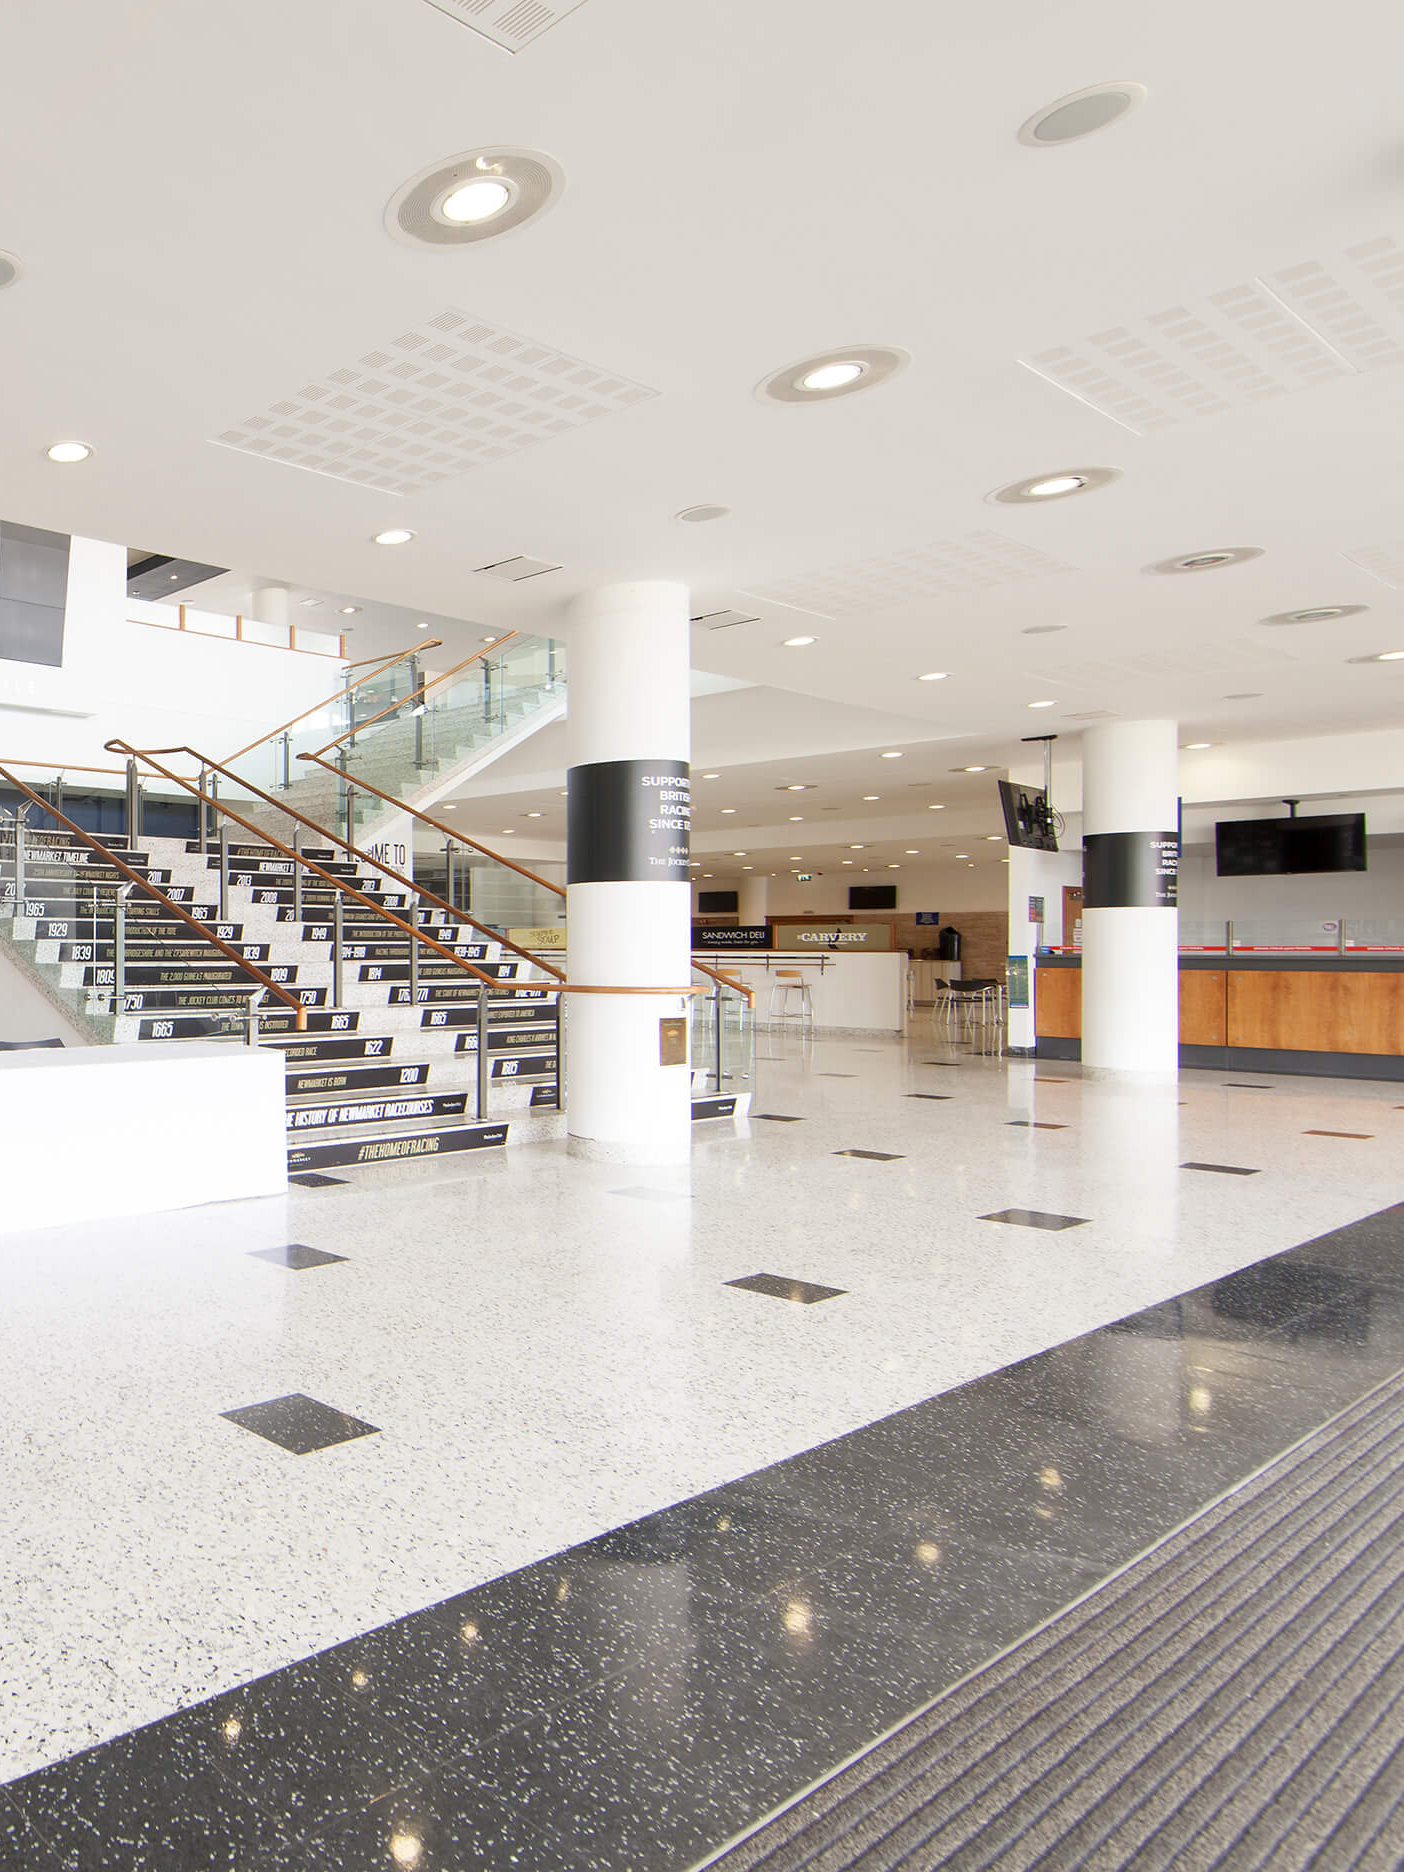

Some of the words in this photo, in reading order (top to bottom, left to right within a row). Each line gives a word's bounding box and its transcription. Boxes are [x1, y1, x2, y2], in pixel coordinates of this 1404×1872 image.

[649, 819, 684, 831] SINCE
[147, 871, 162, 884] 2011
[236, 874, 252, 887] 2013
[166, 888, 184, 901] 2007
[25, 902, 45, 917] 1965
[192, 906, 209, 920] 1965
[48, 923, 68, 937] 1929
[217, 925, 234, 939] 1929
[701, 931, 748, 940] SANDWICH
[749, 931, 765, 939] DELI
[801, 932, 868, 942] CARVERY
[72, 945, 92, 961] 1839
[243, 946, 260, 960] 1839
[270, 968, 288, 983] 1809
[299, 990, 317, 1005] 1750
[151, 1021, 174, 1038] 1665
[331, 1014, 350, 1030] 1665
[364, 1040, 384, 1056] 1622
[297, 1077, 327, 1089] NEWMARKET
[333, 1076, 347, 1087] BORN
[400, 1067, 420, 1084] 1200
[295, 1107, 327, 1126] HISTORY
[327, 1107, 340, 1124] OF
[339, 1102, 386, 1122] NEWMARKET
[384, 1098, 435, 1119] RACECOURSES
[357, 1136, 440, 1162] #THEHOMEOFRACING
